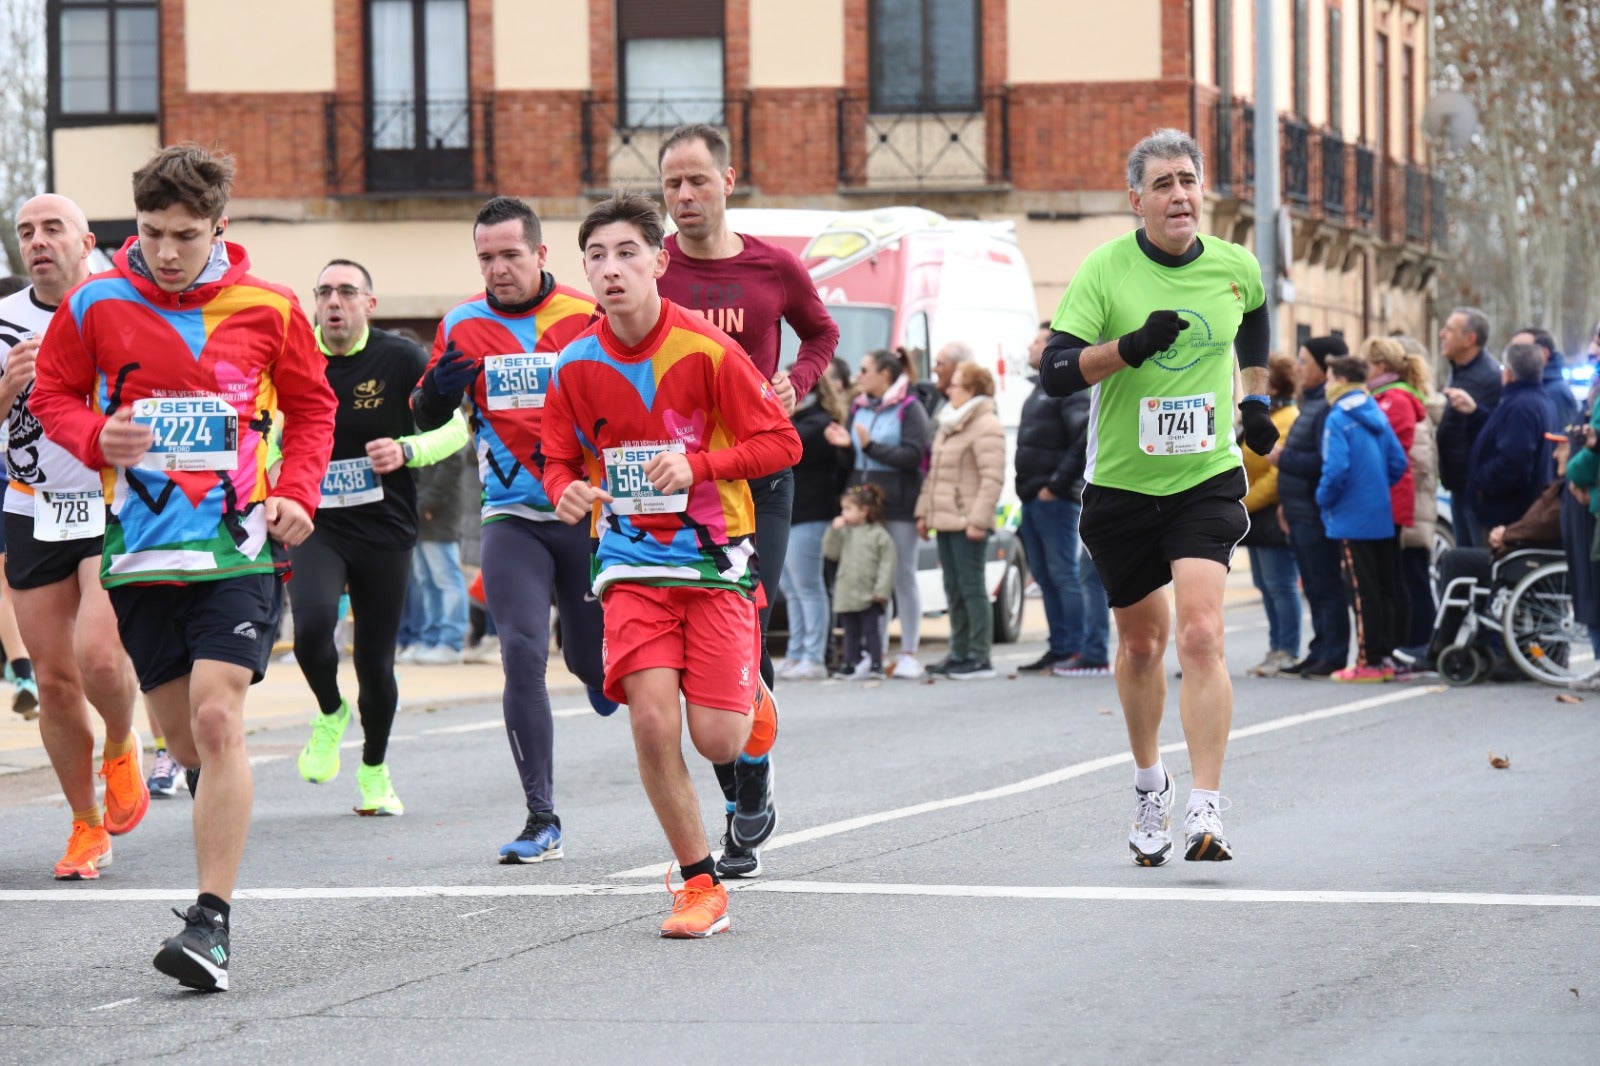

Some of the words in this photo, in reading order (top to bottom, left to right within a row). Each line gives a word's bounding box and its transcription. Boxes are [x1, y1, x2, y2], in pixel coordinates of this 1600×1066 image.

[688, 283, 743, 308] TOP
[504, 356, 551, 367] SETEL
[498, 368, 539, 392] 3516
[160, 401, 227, 414] SETEL
[353, 397, 384, 410] SCF
[150, 416, 212, 447] 4224
[1157, 411, 1194, 436] 1741
[329, 460, 371, 471] SETEL
[625, 450, 670, 461] SET
[323, 470, 366, 492] 4438
[616, 464, 655, 492] 564
[55, 489, 104, 500] SETEL
[52, 501, 89, 524] 728
